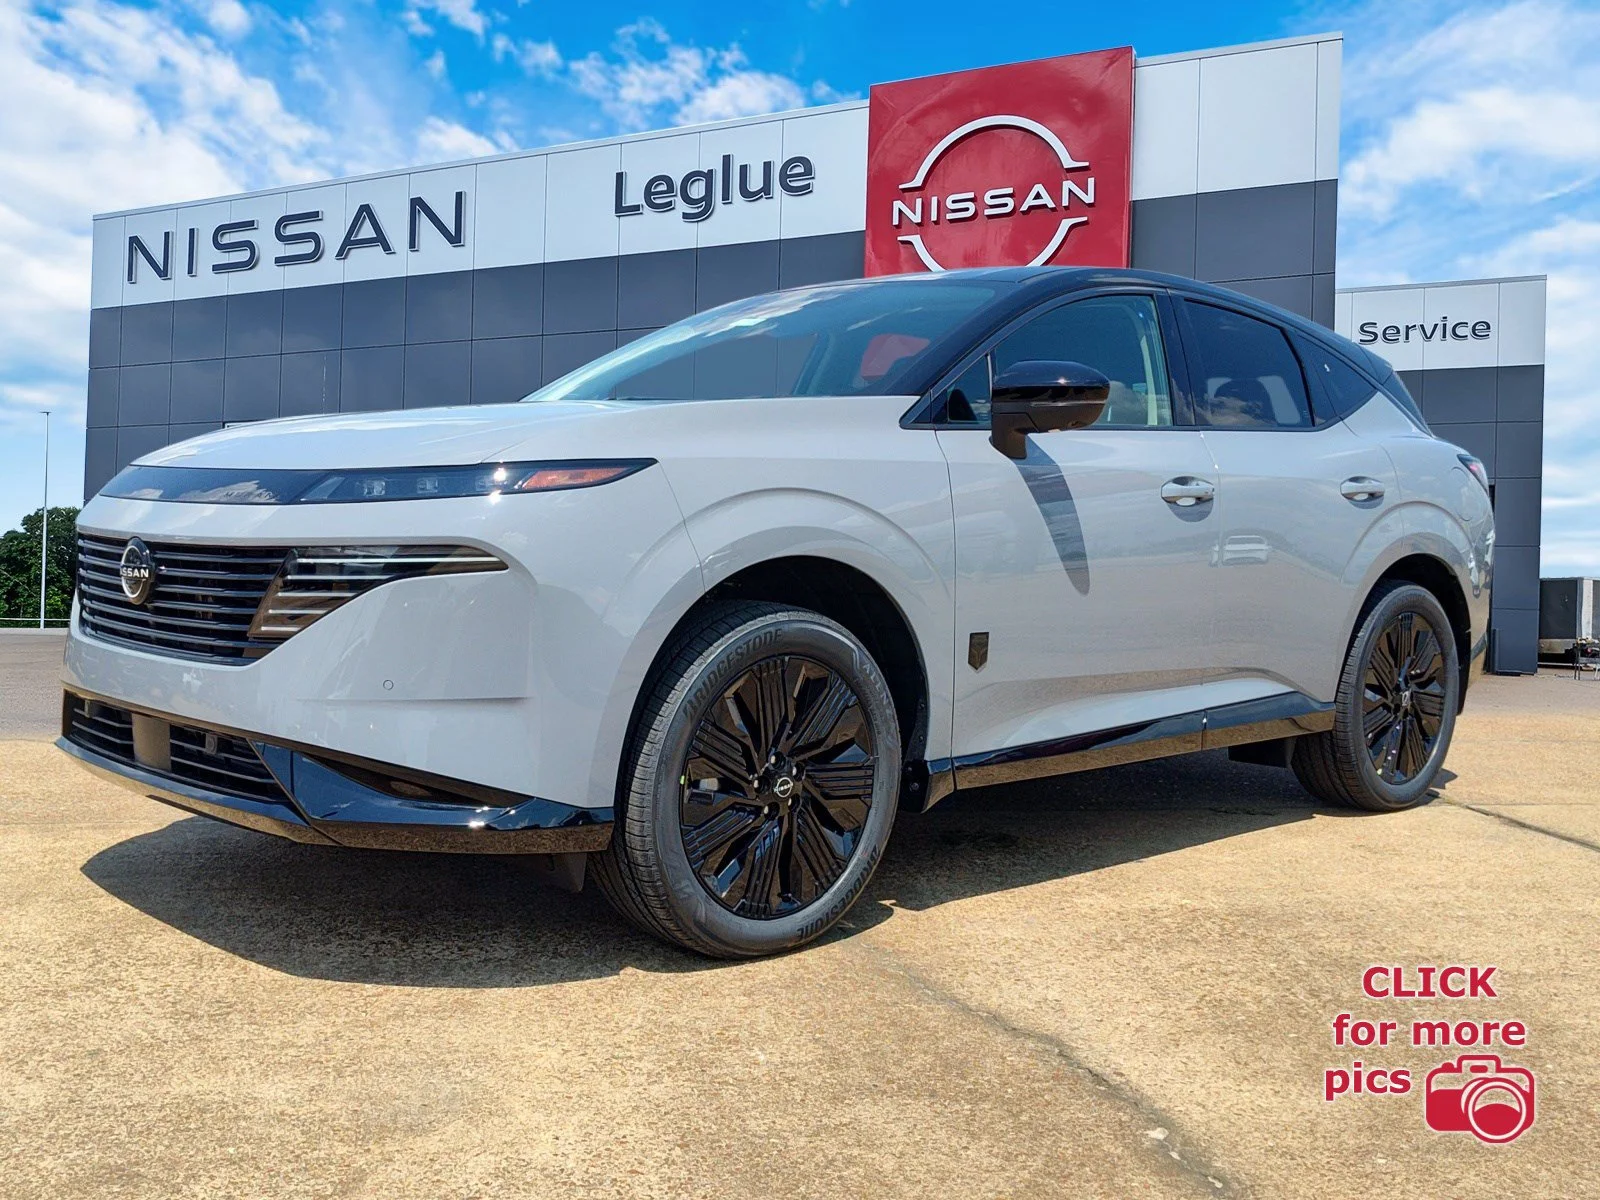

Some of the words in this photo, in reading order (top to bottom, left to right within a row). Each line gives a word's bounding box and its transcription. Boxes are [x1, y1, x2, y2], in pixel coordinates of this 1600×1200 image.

[614, 153, 815, 222] Leglue
[892, 177, 1096, 227] NISSAN
[127, 190, 466, 284] NISSAN
[1358, 315, 1492, 345] Service
